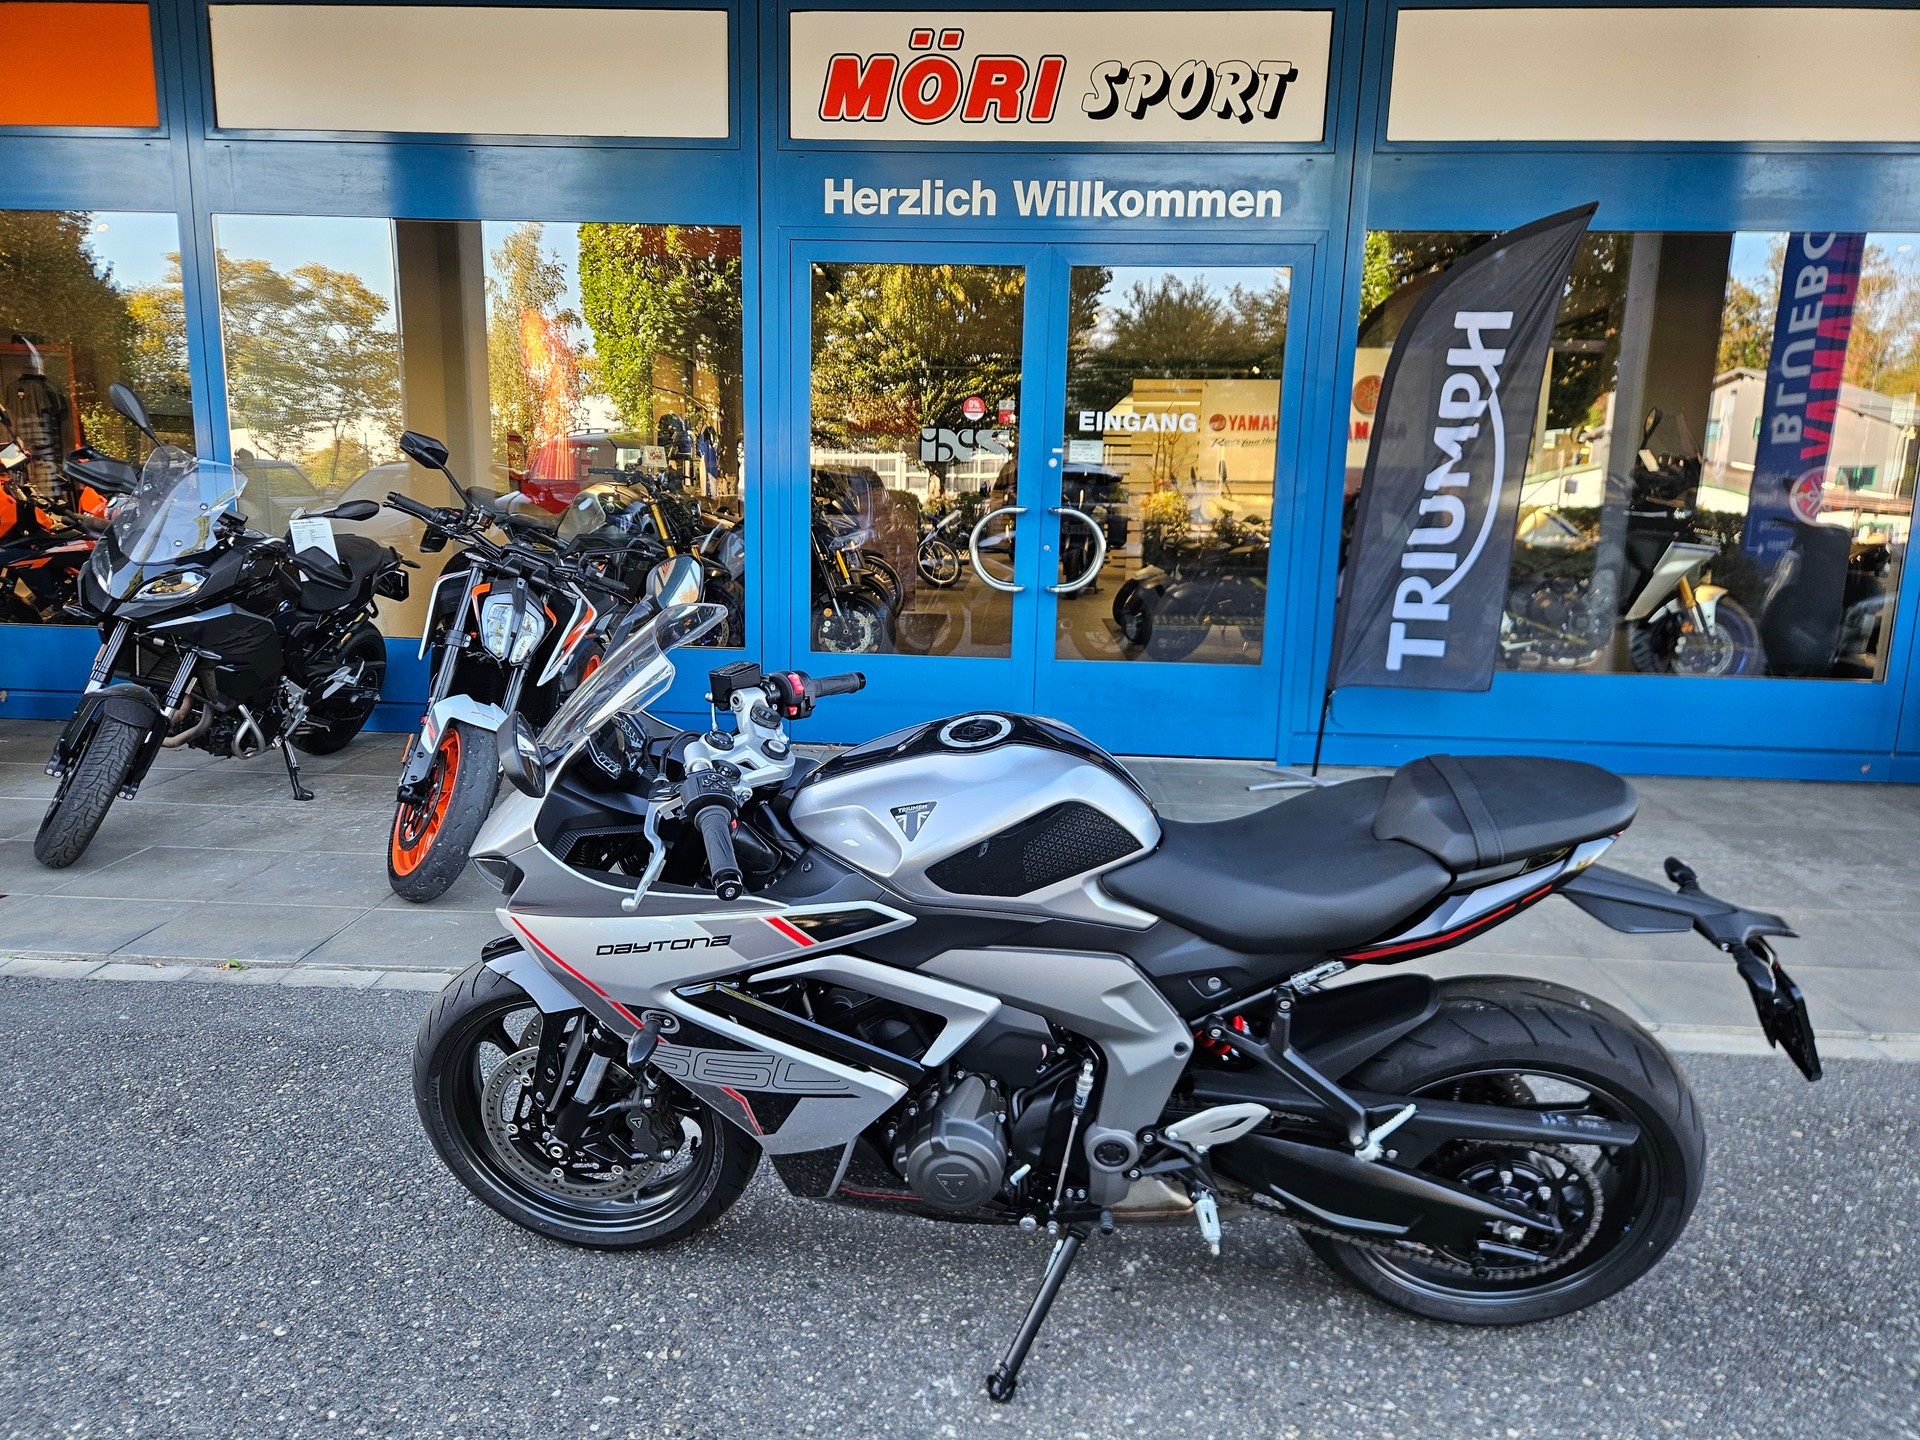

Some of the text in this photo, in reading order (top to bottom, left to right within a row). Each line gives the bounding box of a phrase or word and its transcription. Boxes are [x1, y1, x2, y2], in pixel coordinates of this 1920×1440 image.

[819, 28, 1299, 125] MÖRI SPORT
[824, 178, 1283, 218] Herzlich Willkommen
[1078, 411, 1197, 433] EINGANG
[1386, 311, 1514, 671] TRIUMPH
[897, 803, 929, 814] TRIUMPH
